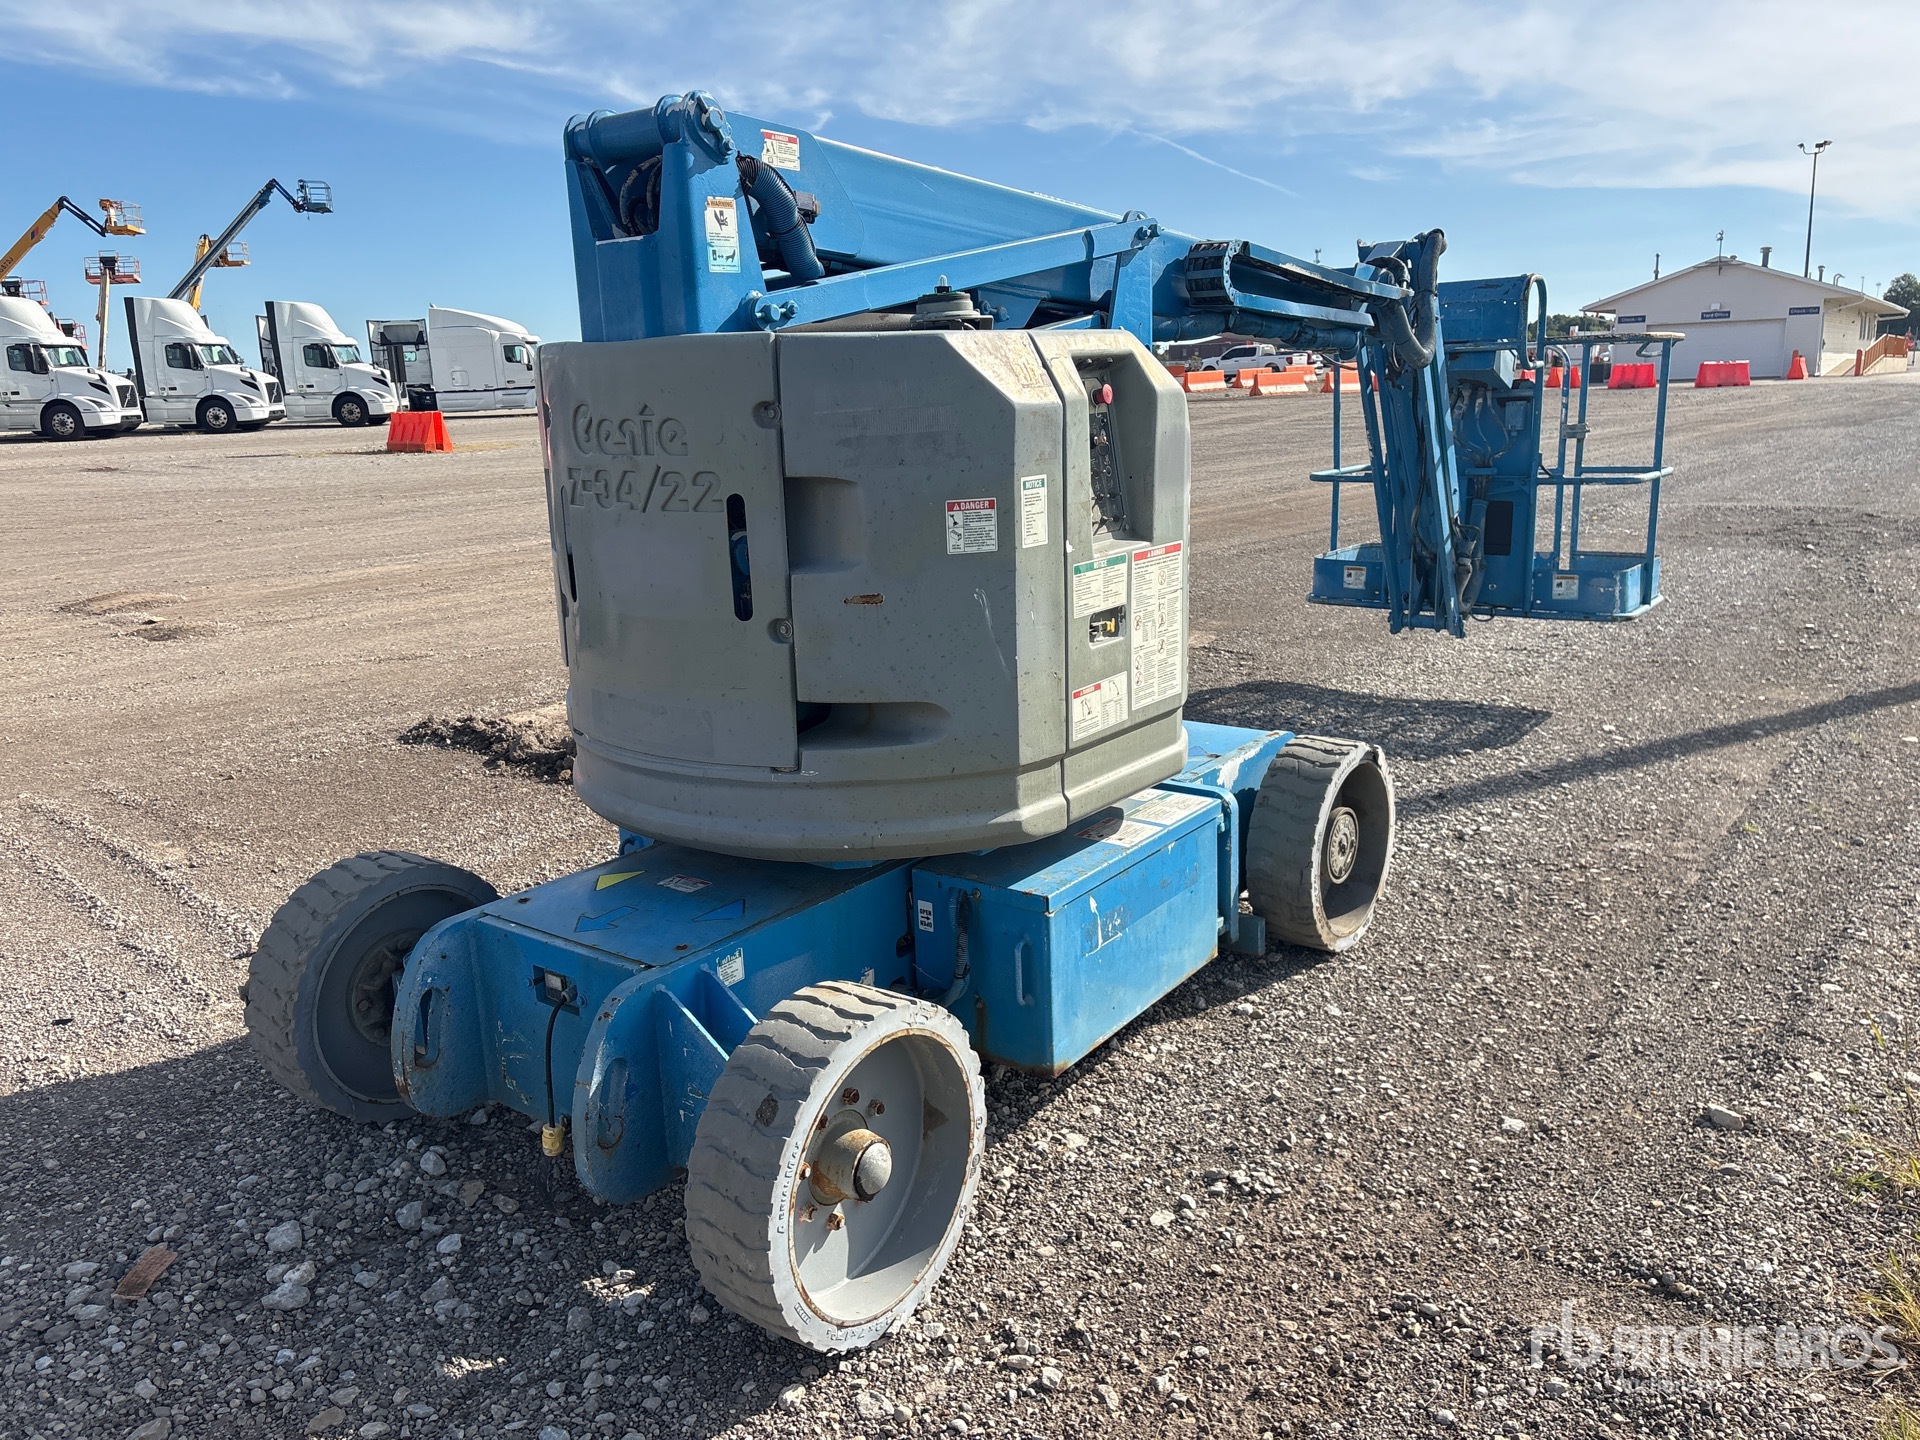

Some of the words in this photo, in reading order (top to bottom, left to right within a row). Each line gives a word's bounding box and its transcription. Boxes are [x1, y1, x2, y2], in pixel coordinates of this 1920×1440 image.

[710, 200, 734, 208] WARNING
[572, 403, 689, 457] Genie
[567, 464, 725, 513] Z-34/22
[1025, 479, 1043, 489] NOTICE
[960, 501, 990, 510] DANGER
